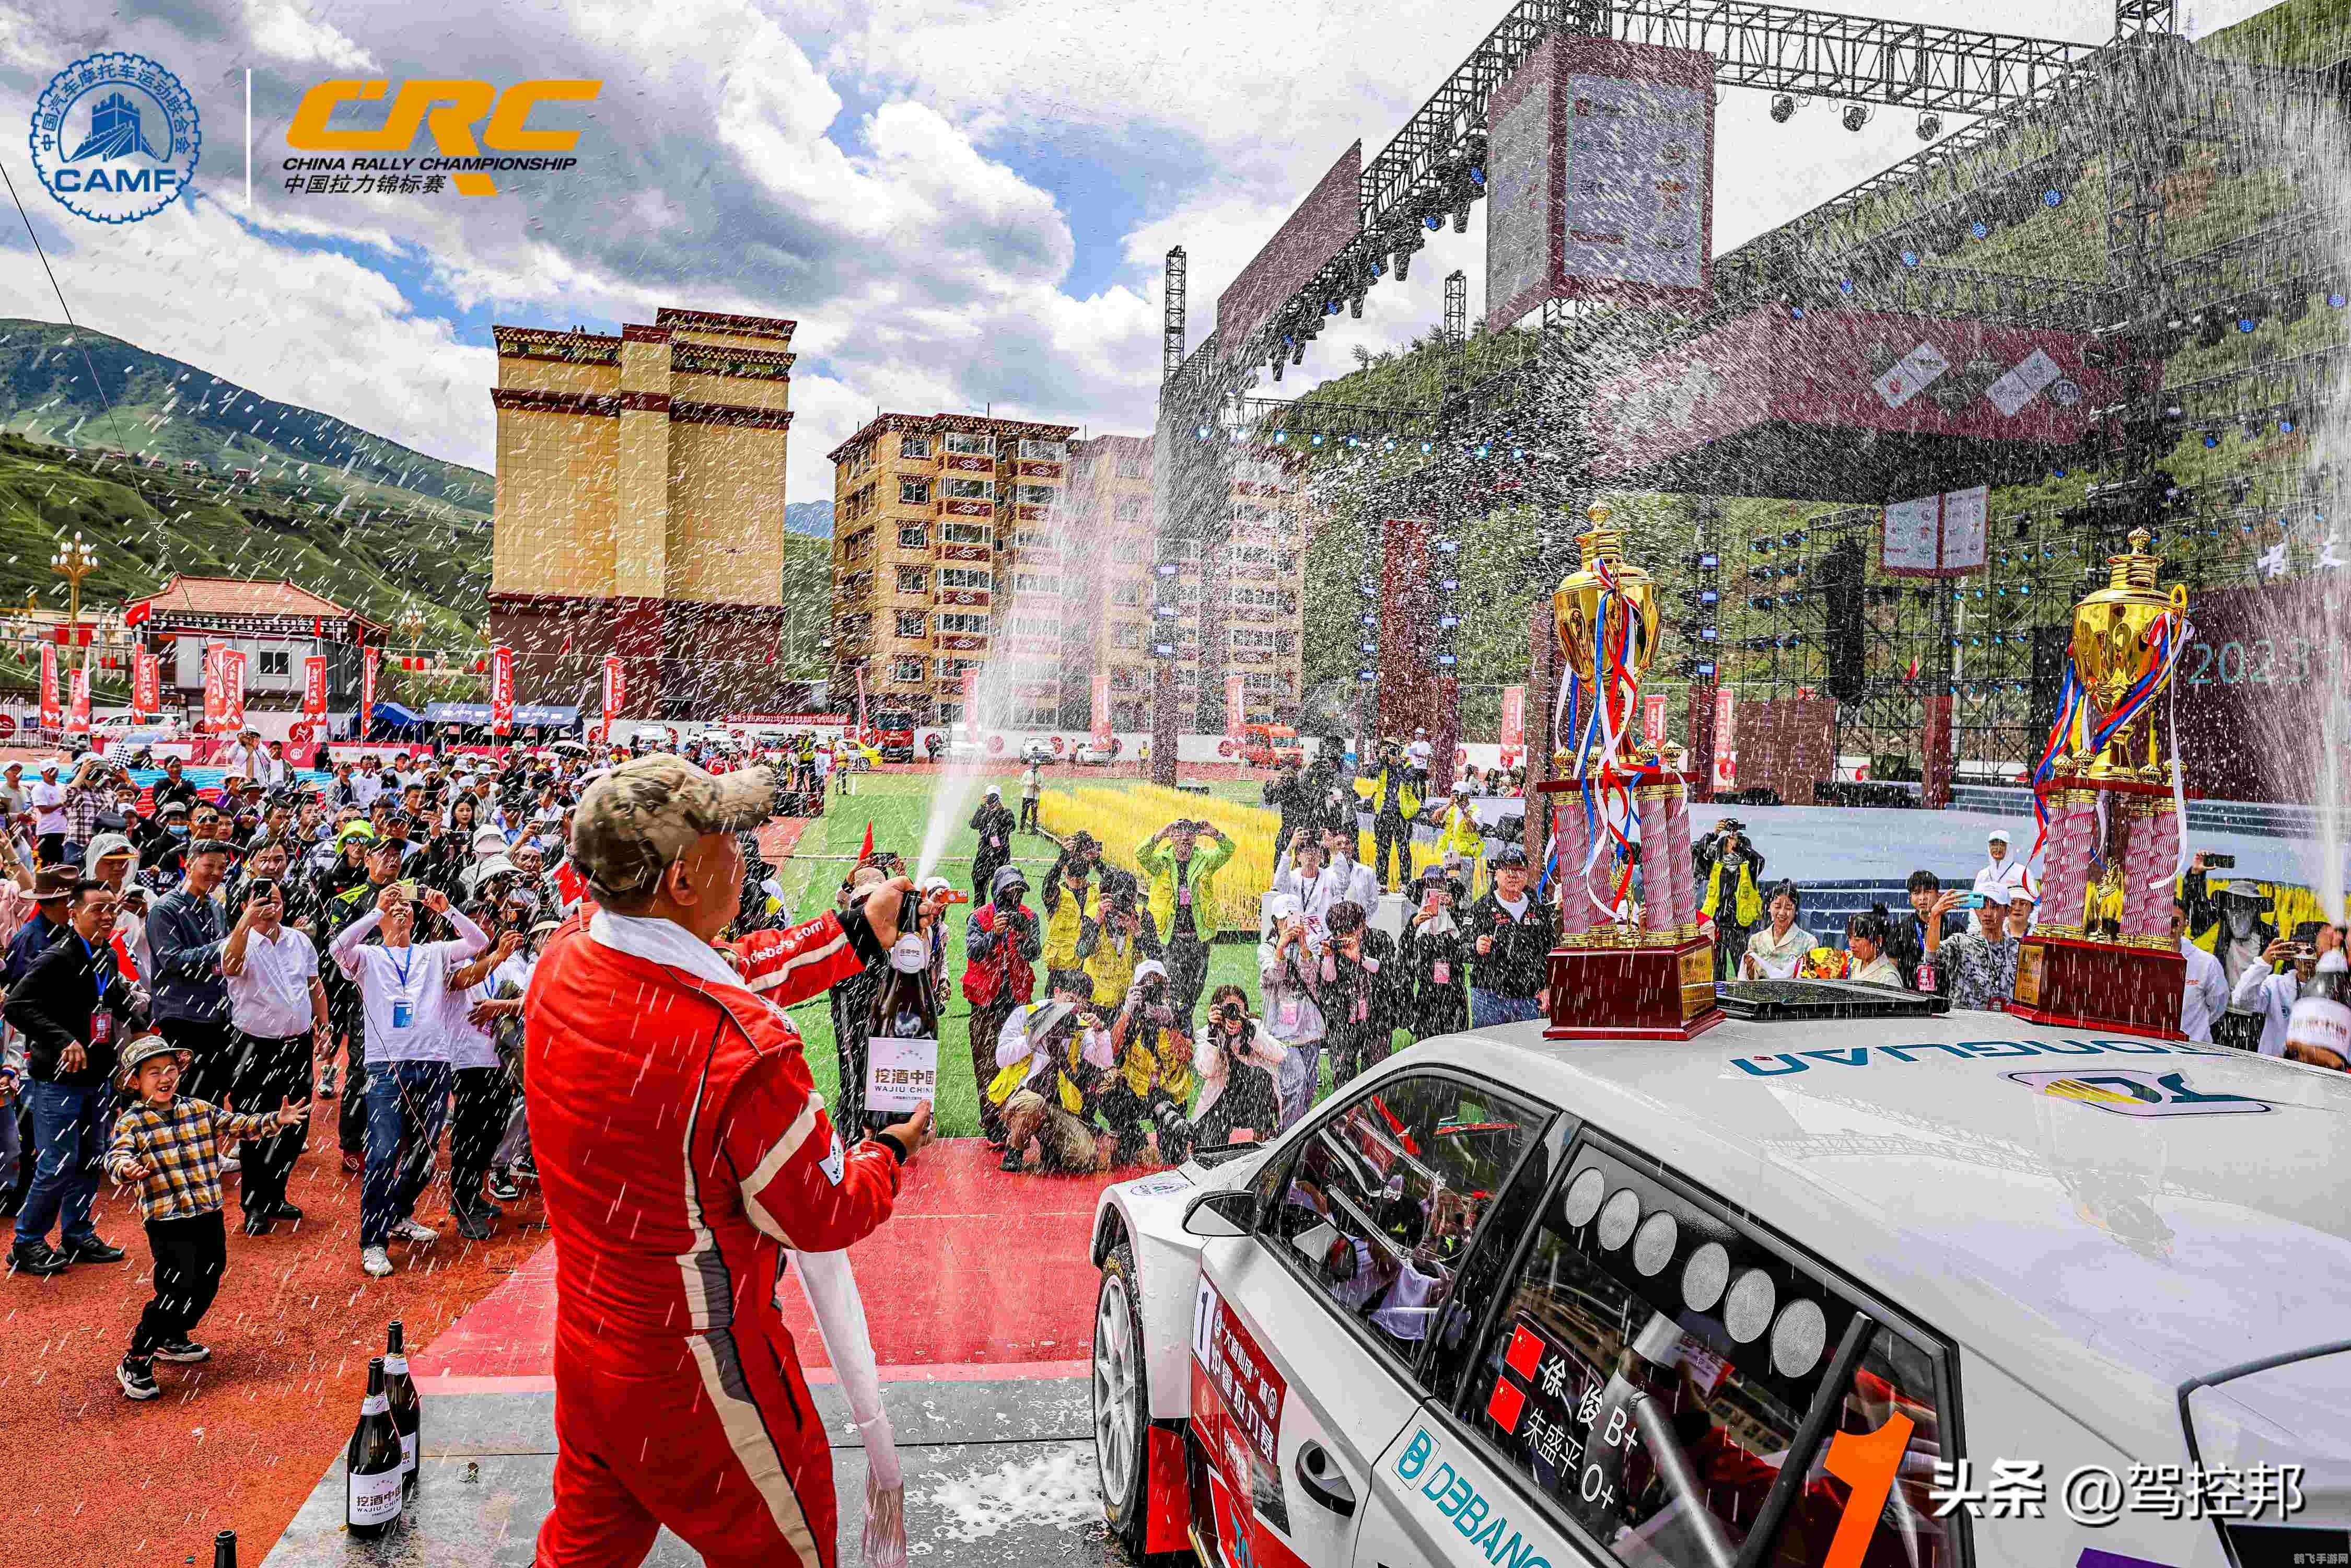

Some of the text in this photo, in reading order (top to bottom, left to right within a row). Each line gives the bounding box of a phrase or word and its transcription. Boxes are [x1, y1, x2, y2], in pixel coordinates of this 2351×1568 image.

[874, 1067, 934, 1085] 挖酒中国
[1199, 1291, 1209, 1352] 1
[1522, 1407, 1584, 1478] 朱盛平
[1603, 1406, 1638, 1452] B+
[355, 1483, 402, 1507] 挖酒中国
[1823, 1410, 1915, 1568] 1
